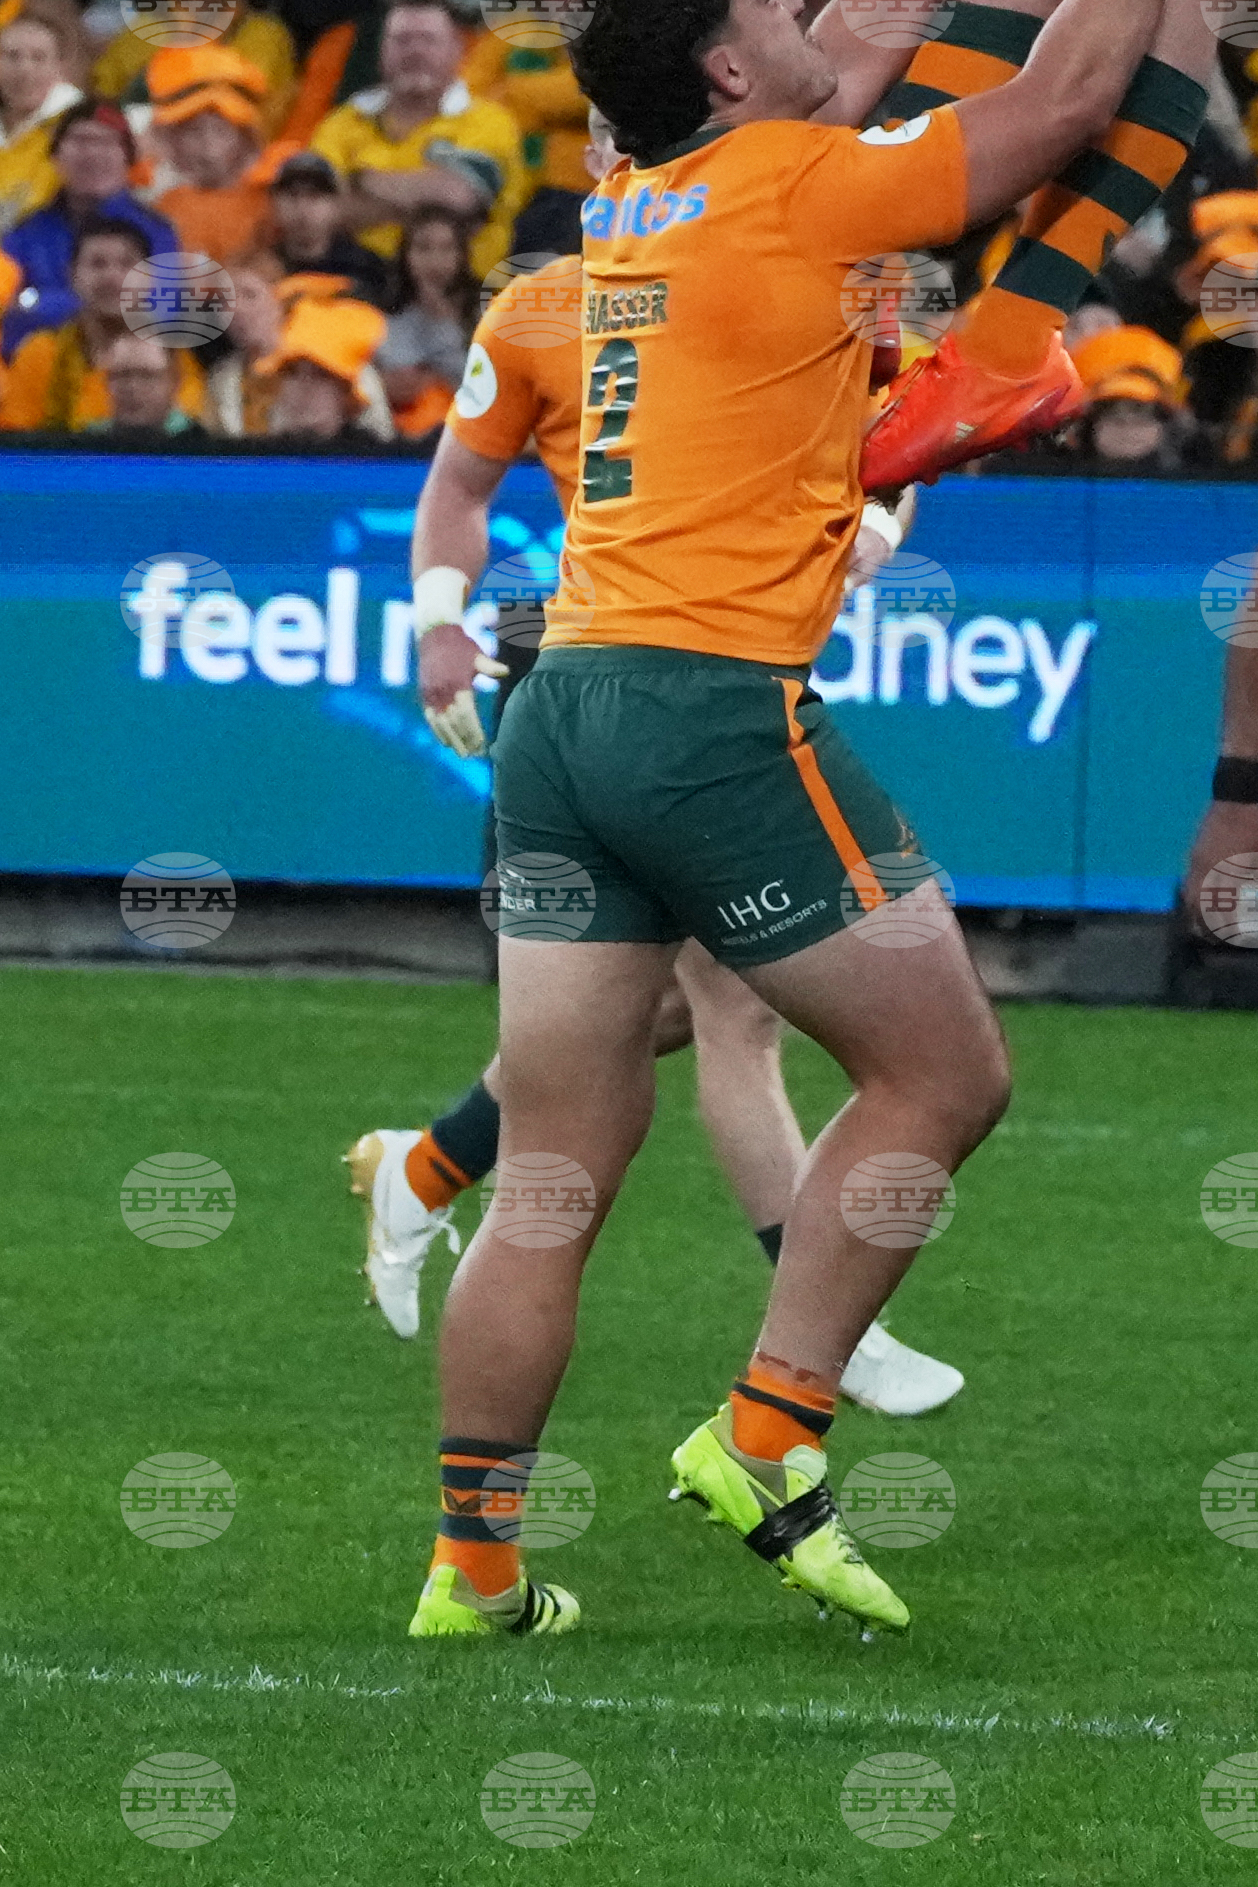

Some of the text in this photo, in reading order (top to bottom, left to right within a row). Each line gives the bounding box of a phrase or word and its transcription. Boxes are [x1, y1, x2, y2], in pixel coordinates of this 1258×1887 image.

[583, 337, 639, 503] 2
[126, 560, 360, 687] feel
[808, 583, 1098, 743] dney
[718, 881, 791, 930] IHG
[769, 899, 827, 935] RESORTS
